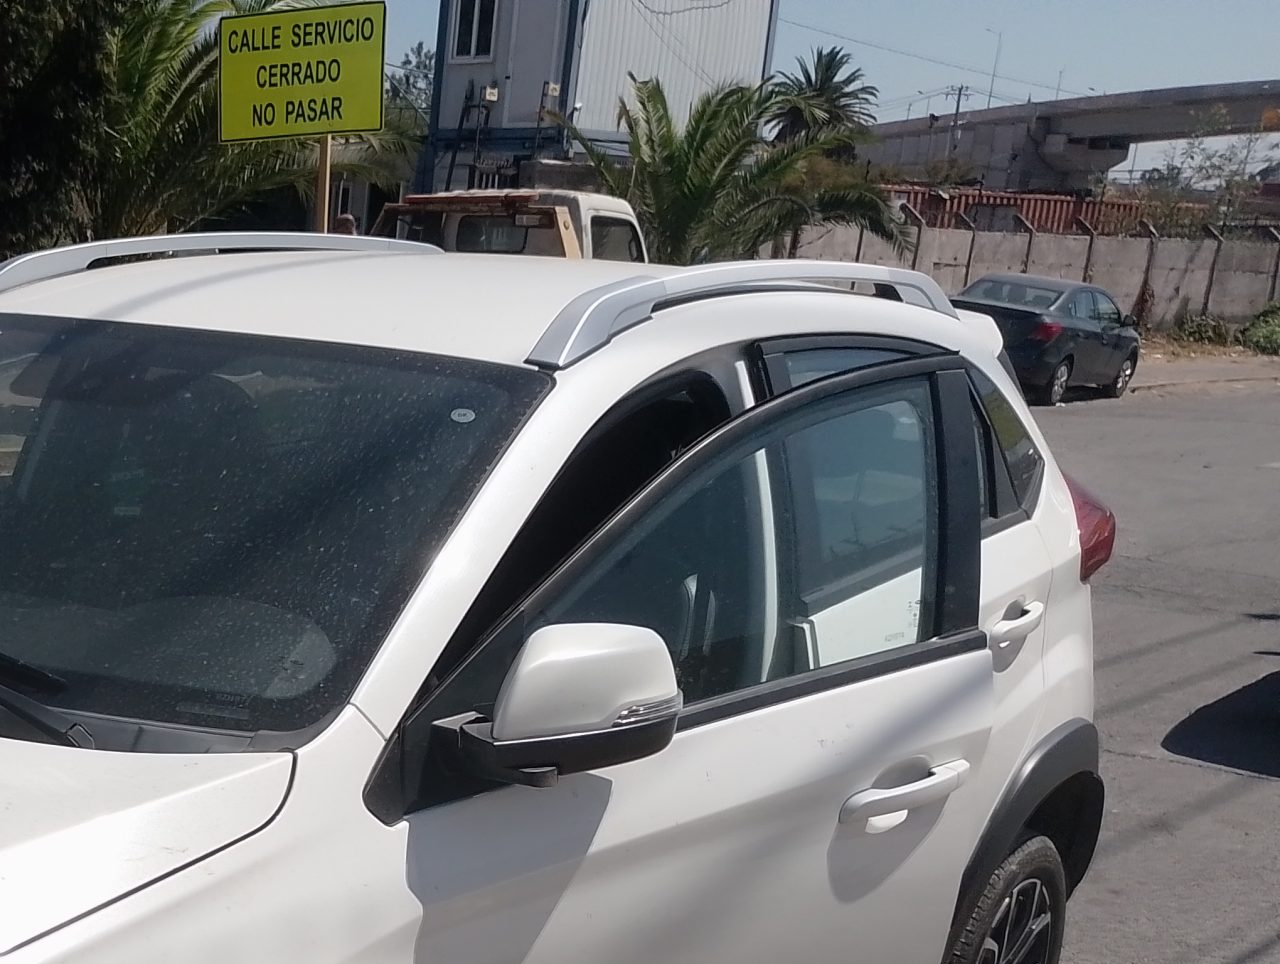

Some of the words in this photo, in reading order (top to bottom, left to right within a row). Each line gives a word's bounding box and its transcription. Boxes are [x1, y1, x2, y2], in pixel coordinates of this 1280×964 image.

[228, 26, 282, 53] CALLE
[291, 17, 374, 47] SERVICIO
[256, 59, 341, 88] CERRADO
[252, 103, 276, 127] NO
[285, 97, 343, 124] PASAR
